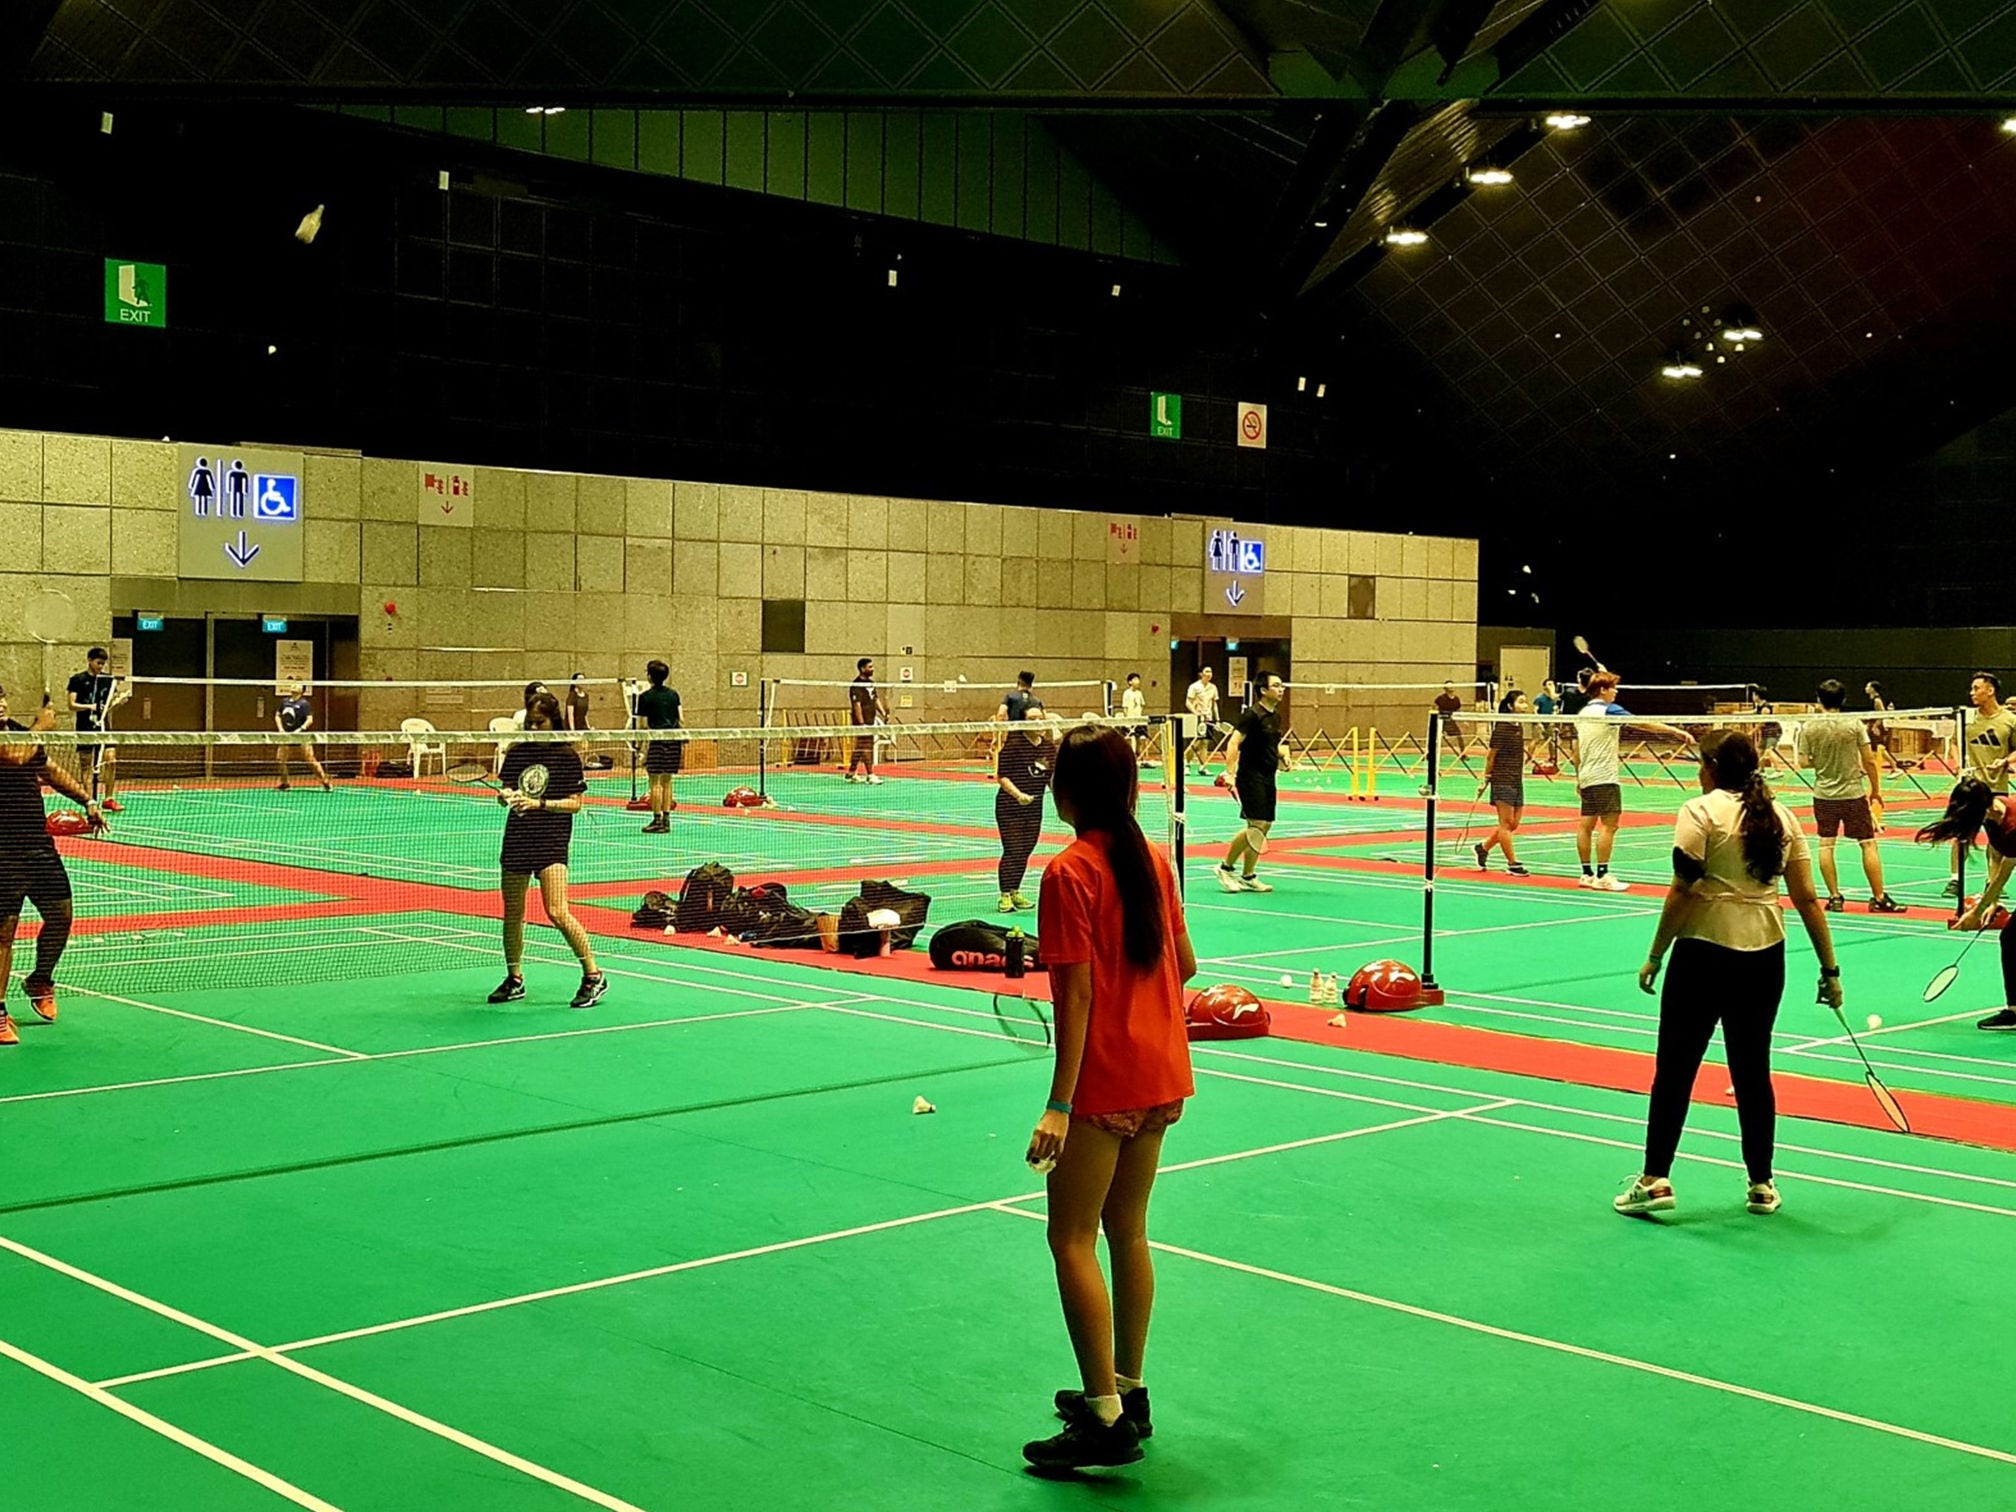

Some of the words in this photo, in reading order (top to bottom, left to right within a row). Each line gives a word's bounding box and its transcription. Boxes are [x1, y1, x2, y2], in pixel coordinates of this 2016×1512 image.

[120, 308, 151, 322] EXIT
[142, 621, 158, 629] EXIT
[267, 622, 282, 631] EXIT
